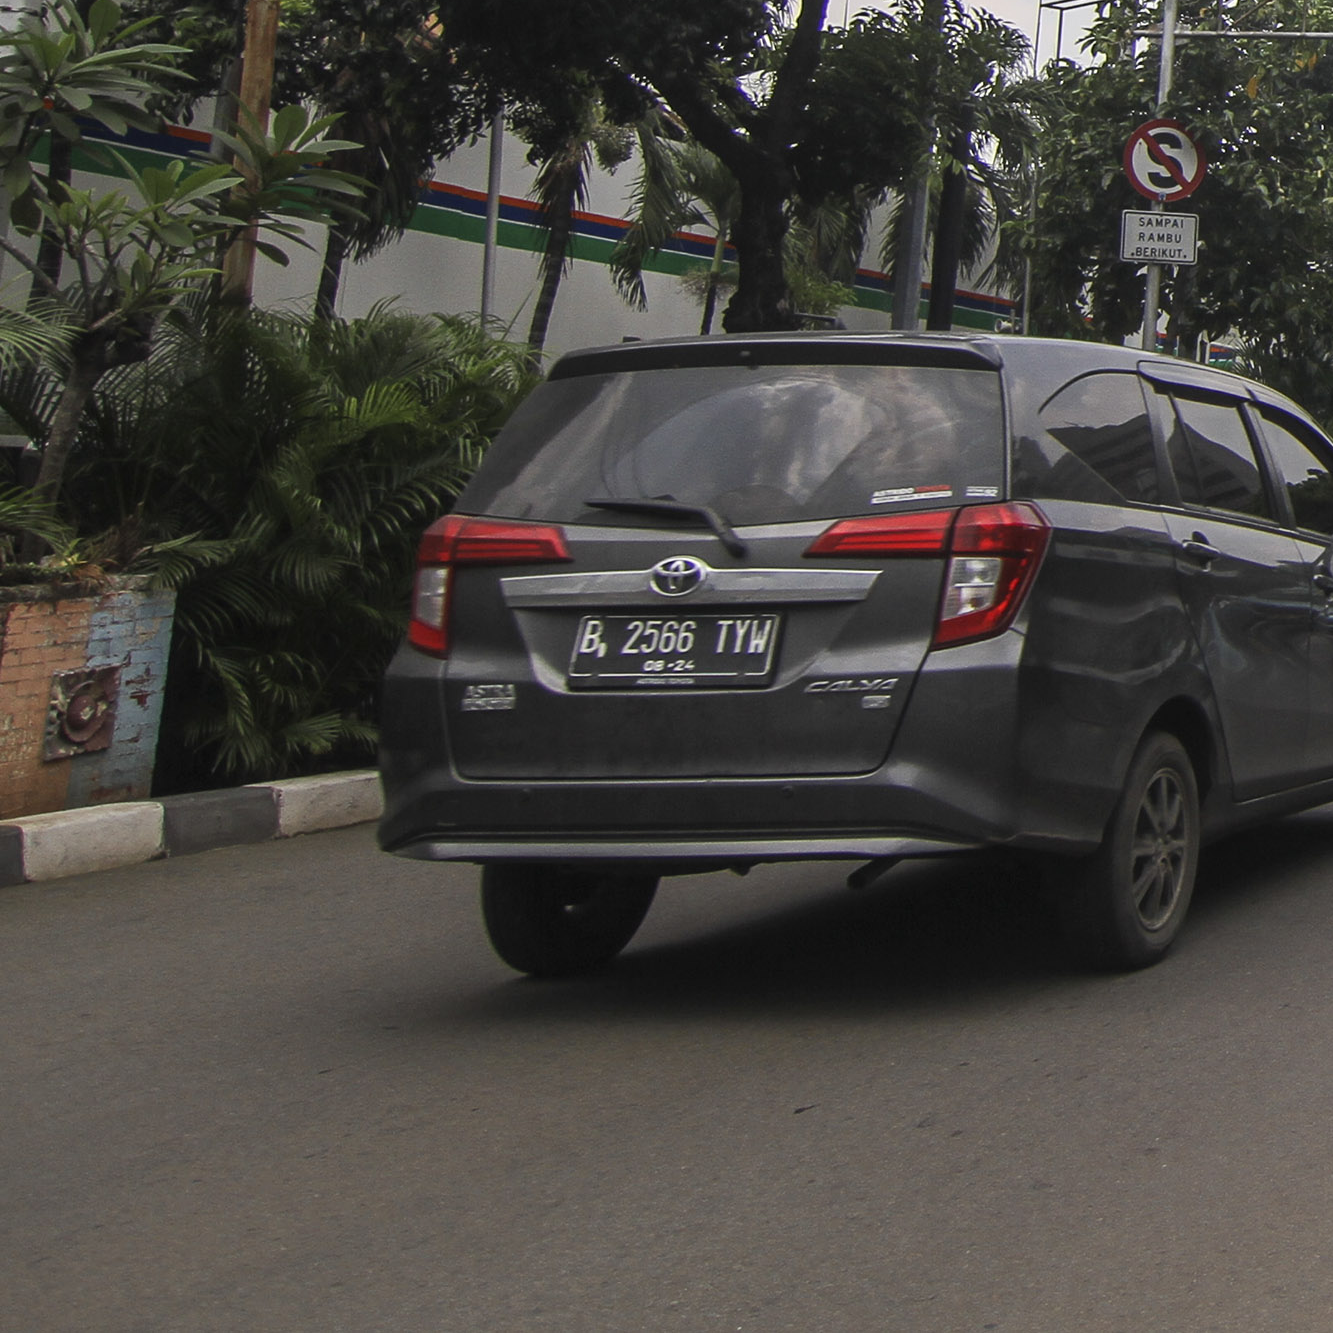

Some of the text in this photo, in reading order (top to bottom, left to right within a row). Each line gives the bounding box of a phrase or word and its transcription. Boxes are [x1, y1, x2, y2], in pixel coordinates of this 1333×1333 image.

[1138, 217, 1184, 229] SAMPAI
[1138, 232, 1182, 244] RAMBU
[1135, 247, 1183, 259] BERIKUT
[579, 619, 772, 655] B 2566 TYW
[804, 678, 899, 693] CALYA
